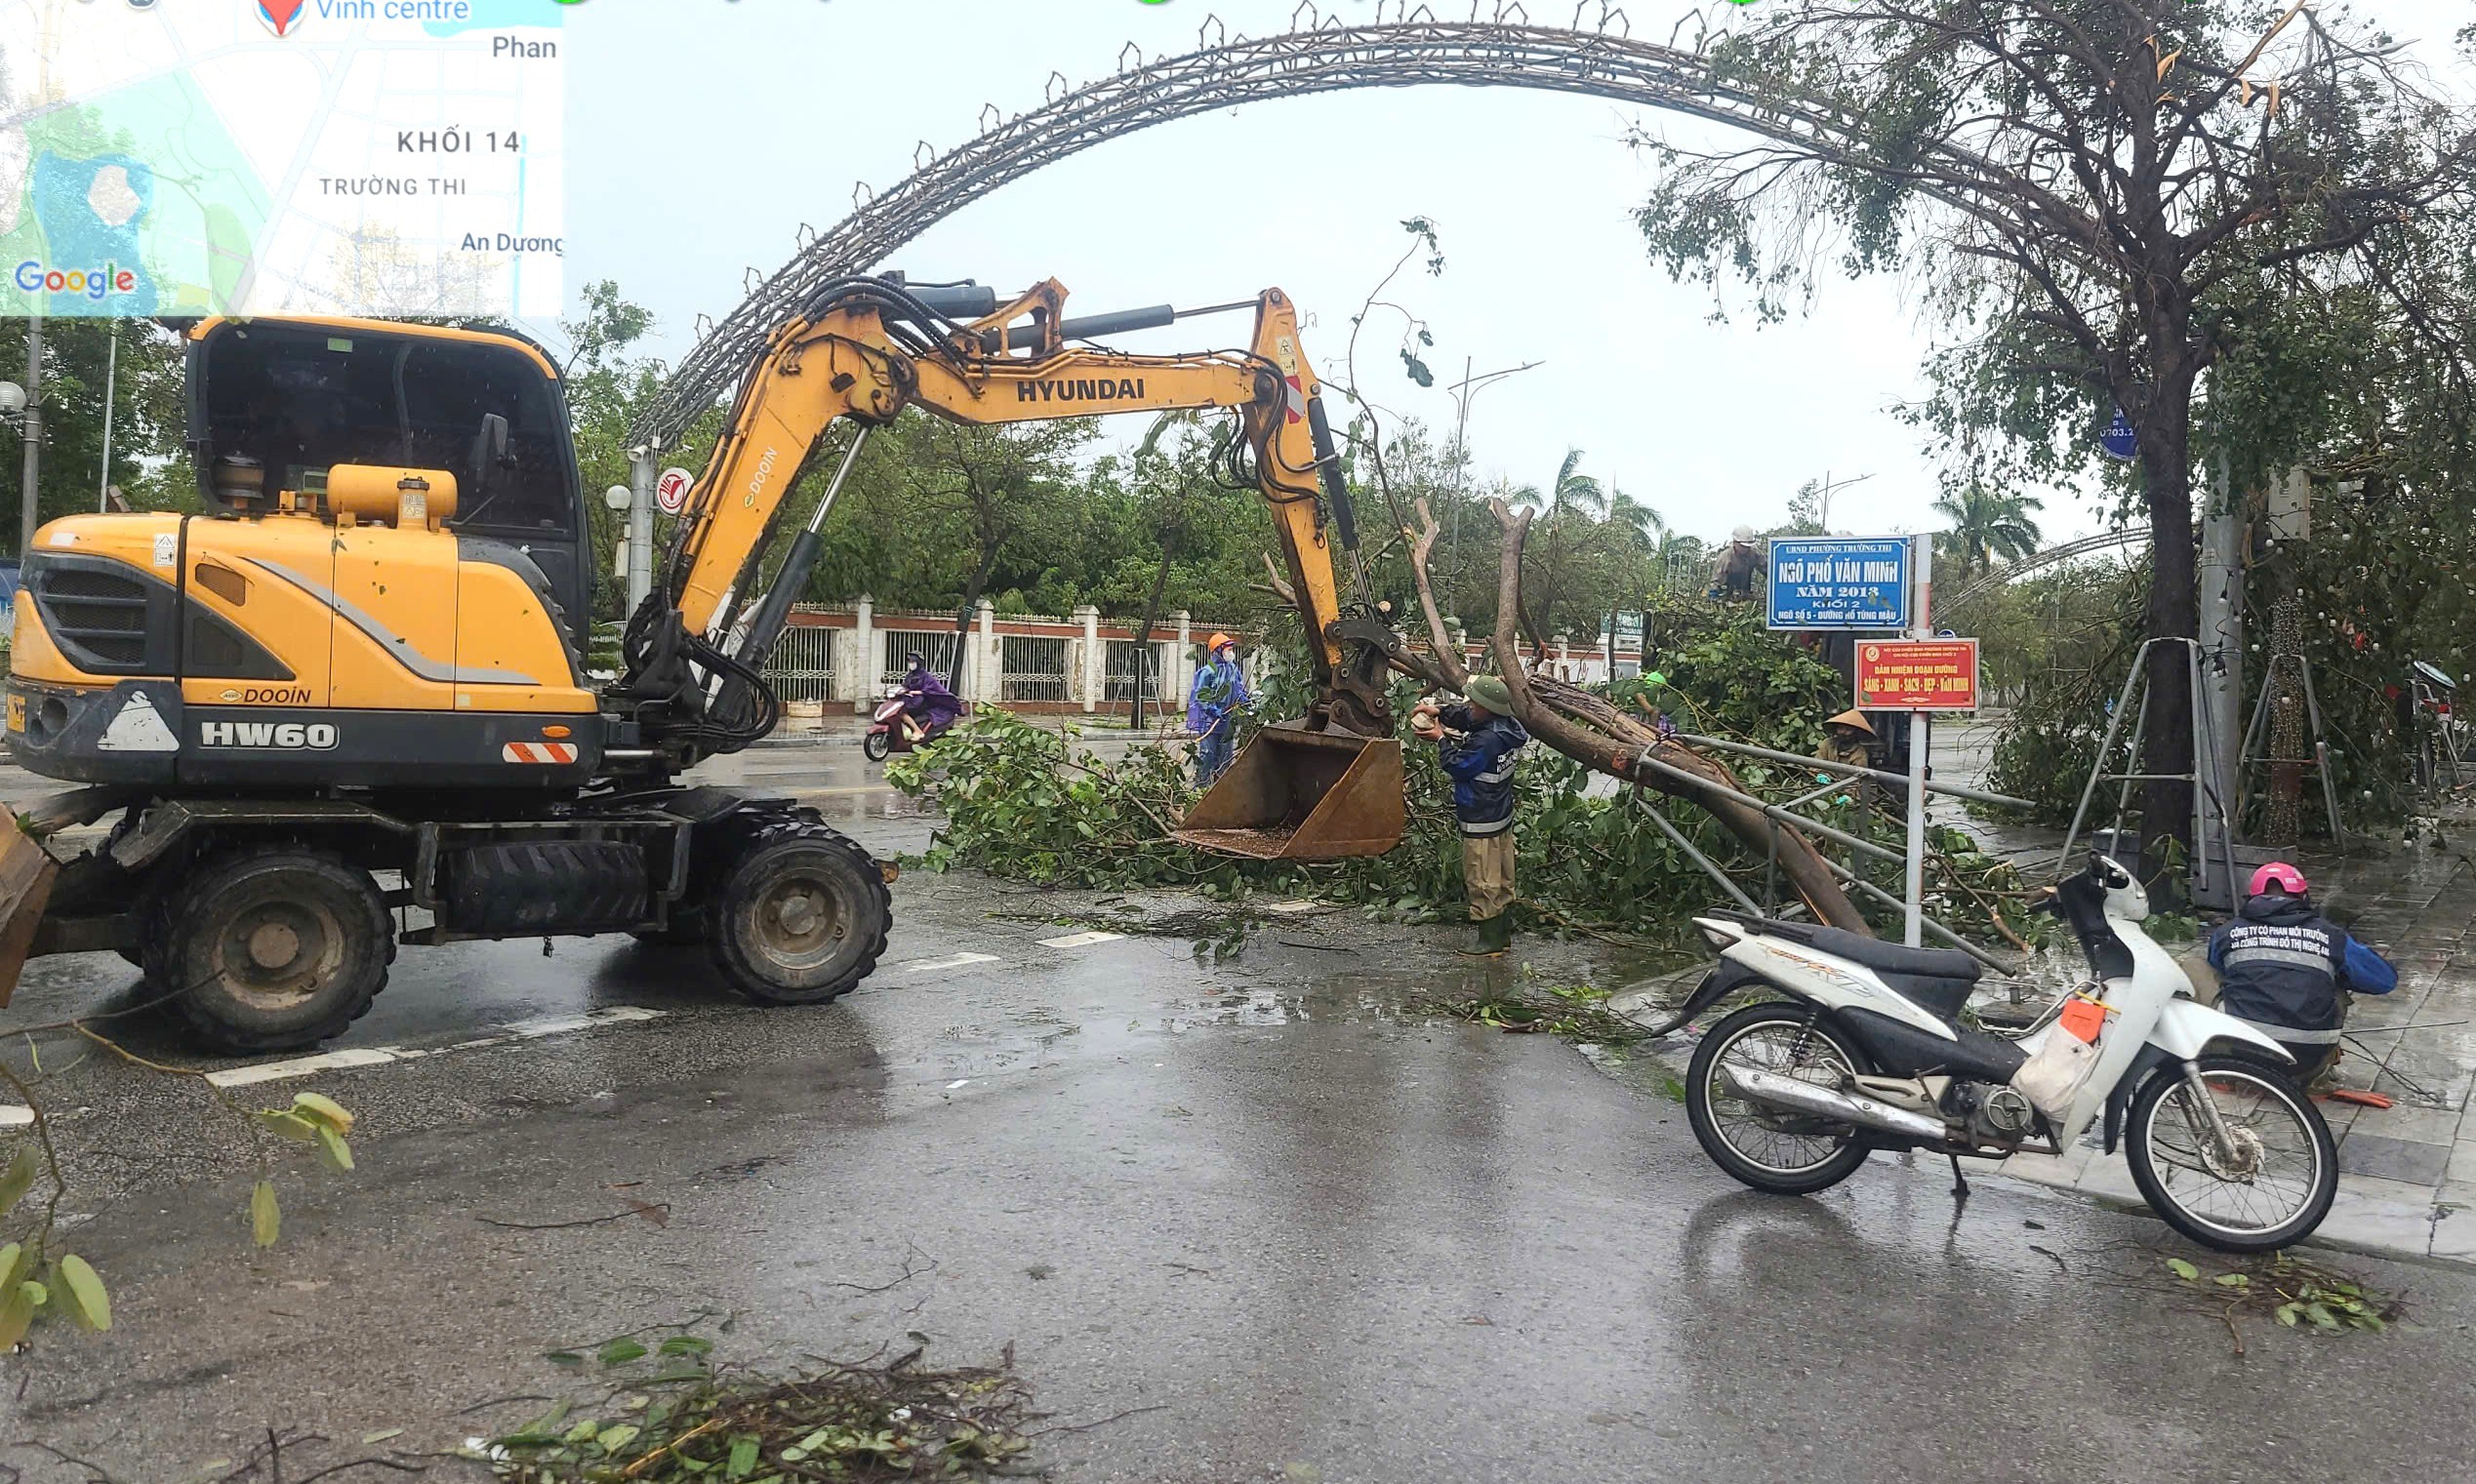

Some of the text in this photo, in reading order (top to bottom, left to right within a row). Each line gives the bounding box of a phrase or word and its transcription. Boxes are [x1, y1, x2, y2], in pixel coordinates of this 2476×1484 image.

[1016, 379, 1145, 402] HYUNDAI
[749, 446, 778, 495] DOOIN
[1778, 554, 1898, 583] NGÕ PHỐ VĂN MINH
[1796, 584, 1833, 597] NĂM
[1806, 611, 1811, 620] 5
[201, 722, 336, 748] HW60
